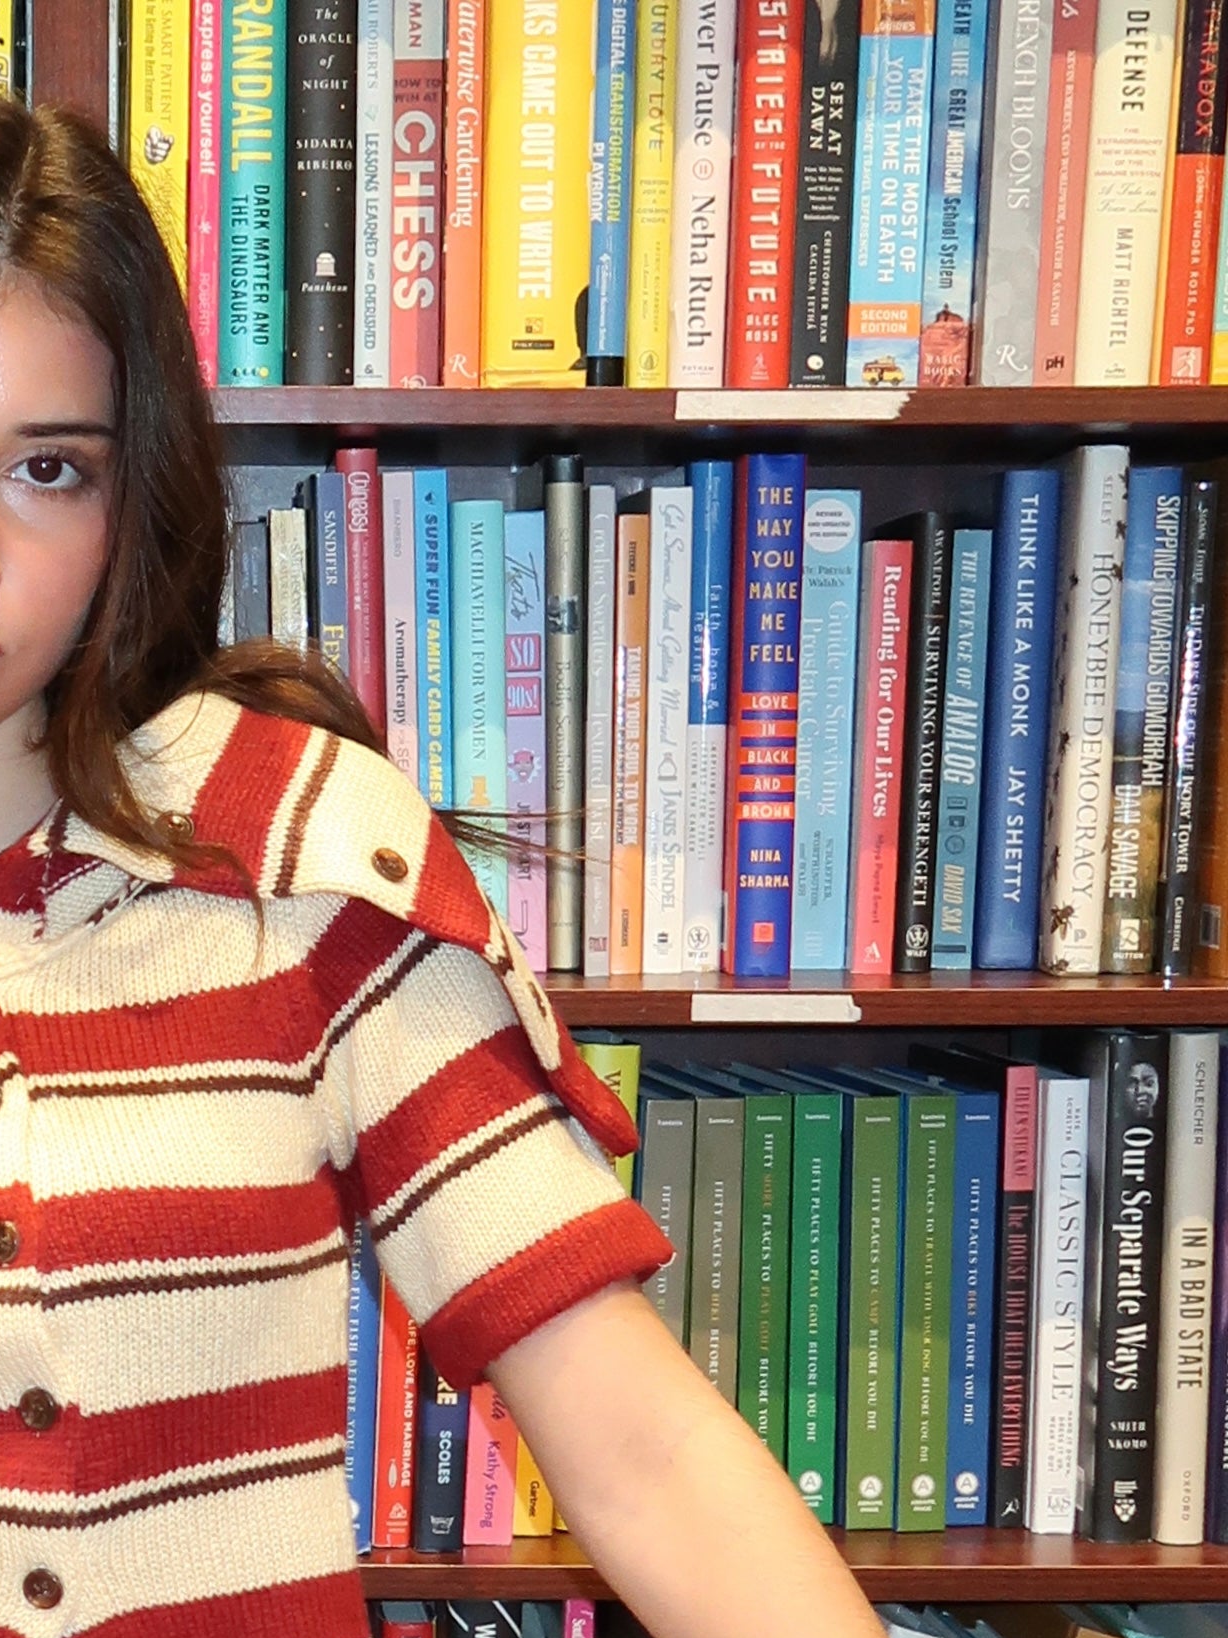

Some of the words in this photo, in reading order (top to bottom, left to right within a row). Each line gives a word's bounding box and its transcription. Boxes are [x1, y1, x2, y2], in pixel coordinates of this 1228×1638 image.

[197, 3, 214, 86] express
[298, 33, 352, 45] ORACLE
[230, 0, 275, 172] RANDALL
[302, 79, 349, 91] NIGHT
[522, 45, 557, 117] CAME
[693, 63, 721, 147] Pause
[829, 81, 845, 120] SEX
[883, 57, 904, 115] YOUR
[905, 68, 925, 128] MAKE
[198, 88, 215, 176] yourself
[296, 138, 354, 150] SIDARTA
[520, 123, 557, 173] OUT
[607, 72, 626, 223] TRANSFORMATION
[808, 86, 826, 150] DAWN
[826, 128, 844, 156] AT
[881, 121, 901, 172] TIME
[297, 160, 353, 171] RIBEIRO
[903, 134, 923, 175] THE
[1007, 96, 1034, 211] BLOOMS
[232, 195, 249, 228] THE
[253, 184, 271, 231] DARK
[393, 111, 436, 311] CHESS
[520, 182, 554, 212] TO
[879, 179, 899, 207] ON
[900, 181, 921, 242] MOST
[941, 196, 961, 242] School
[689, 195, 717, 262] Neha
[747, 163, 782, 303] FUTURE
[877, 214, 898, 283] EARTH
[1113, 228, 1134, 273] MATT
[230, 235, 248, 337] DINOSAURS
[252, 238, 270, 307] MATTER
[518, 221, 554, 300] WRITE
[898, 249, 919, 273] OF
[937, 243, 957, 290] System
[251, 311, 269, 346] AND
[686, 275, 713, 349] Ruch
[1108, 280, 1132, 349] RICHTEL
[758, 486, 793, 505] THE
[324, 510, 338, 586] SANDIFER
[424, 514, 439, 573] SUPER
[757, 518, 793, 537] WAY
[1019, 494, 1039, 571] THINK
[469, 521, 485, 651] MACHIAVELLI
[752, 550, 796, 568] YOU
[425, 577, 440, 614] FUN
[749, 581, 798, 600] MAKE
[875, 563, 903, 662] Reading
[1017, 577, 1037, 629] LIKE
[427, 618, 443, 685] FAMILY
[761, 613, 787, 631] ME
[1084, 551, 1114, 708] HONEYBEE
[391, 616, 411, 727] Aromatherapy
[471, 654, 485, 685] FOR
[750, 644, 795, 663] FEEL
[428, 688, 443, 737] CARD
[877, 668, 897, 701] for
[1009, 663, 1031, 737] MONK
[471, 689, 486, 761] WOMEN
[874, 707, 896, 752] Our
[944, 692, 974, 787] ANALOG
[429, 741, 444, 804] GAMES
[748, 748, 790, 764] BLACK
[1007, 765, 1028, 807] JAY
[872, 757, 894, 818] Lives
[1072, 716, 1104, 899] DEMOCRACY
[660, 842, 682, 912] SPINDEL
[739, 874, 790, 888] SHARMA
[750, 848, 781, 863] NINA
[1003, 814, 1024, 903] SHETTY
[1108, 828, 1140, 902] SAVAGE
[1192, 1060, 1206, 1146] SCHLEICHER
[1121, 1127, 1155, 1183] Our
[1057, 1149, 1082, 1290] CLASSIC
[1182, 1226, 1208, 1249] IN
[1112, 1188, 1152, 1316] Separate
[1179, 1279, 1205, 1321] BAD
[1050, 1300, 1077, 1401] STYLE
[1106, 1323, 1148, 1392] Ways
[1175, 1328, 1203, 1391] STATE
[437, 1430, 453, 1485] SCOLES
